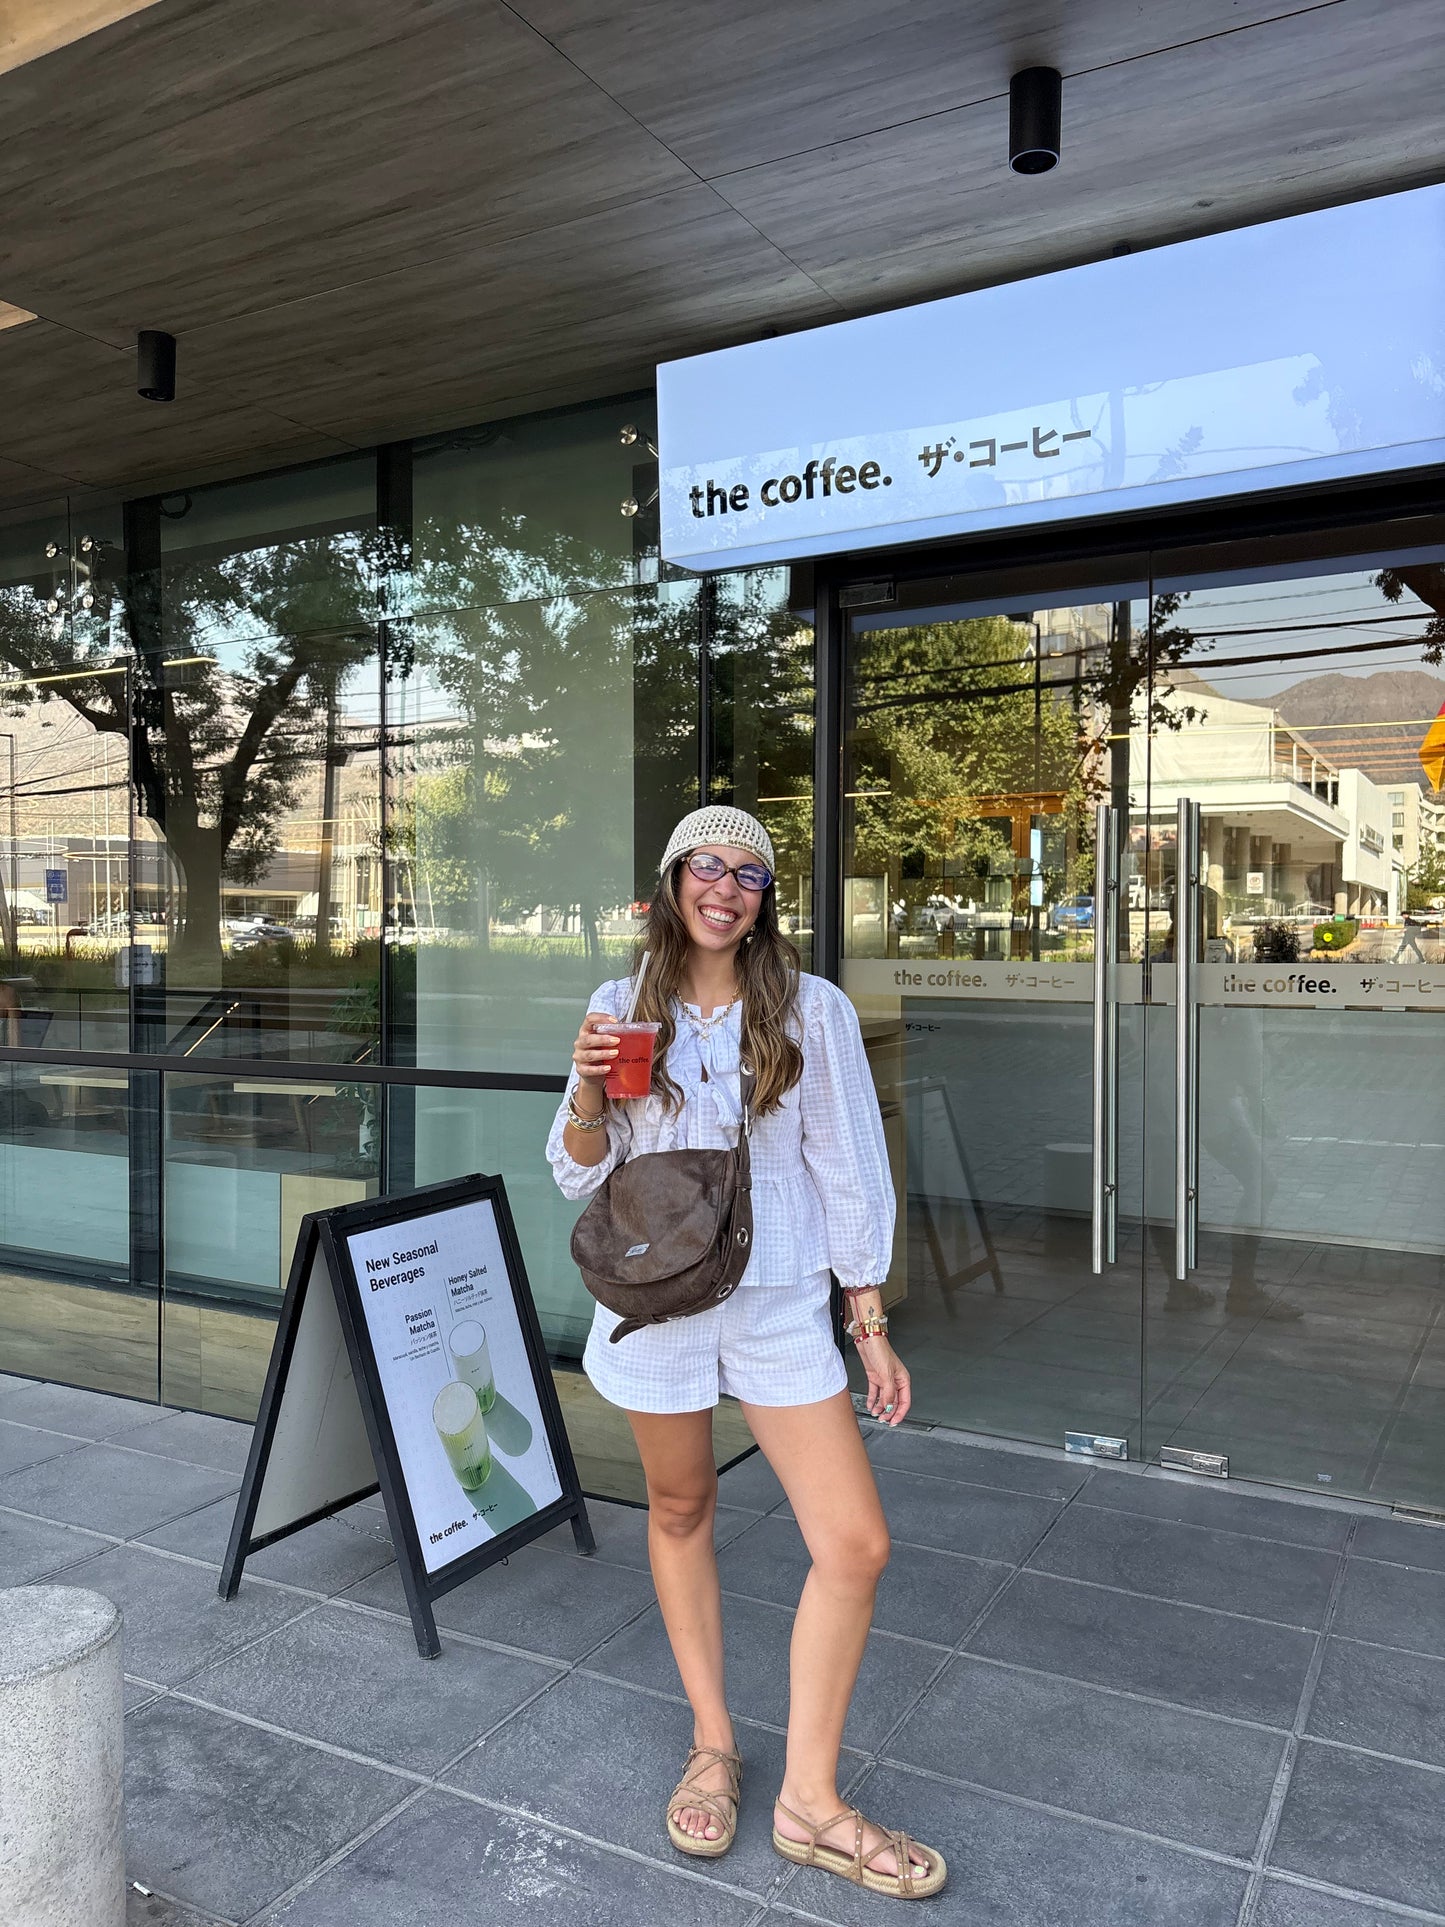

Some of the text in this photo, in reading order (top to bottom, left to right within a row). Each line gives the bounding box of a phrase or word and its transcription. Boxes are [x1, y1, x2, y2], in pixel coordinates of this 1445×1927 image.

[689, 426, 1091, 519] the coffee. ザ・コーヒー
[894, 969, 1075, 989] the coffee. ザ・コーヒー
[1223, 974, 1256, 992] the
[1262, 974, 1337, 993] coffee.
[365, 1239, 439, 1273] New Seasonal
[369, 1266, 425, 1292] Beverages
[448, 1264, 488, 1285] Honey Salted
[450, 1284, 474, 1297] Matcha
[404, 1308, 433, 1324] Passion
[409, 1320, 436, 1335] Matcha
[429, 1532, 443, 1544] the
[443, 1519, 469, 1537] coffee.
